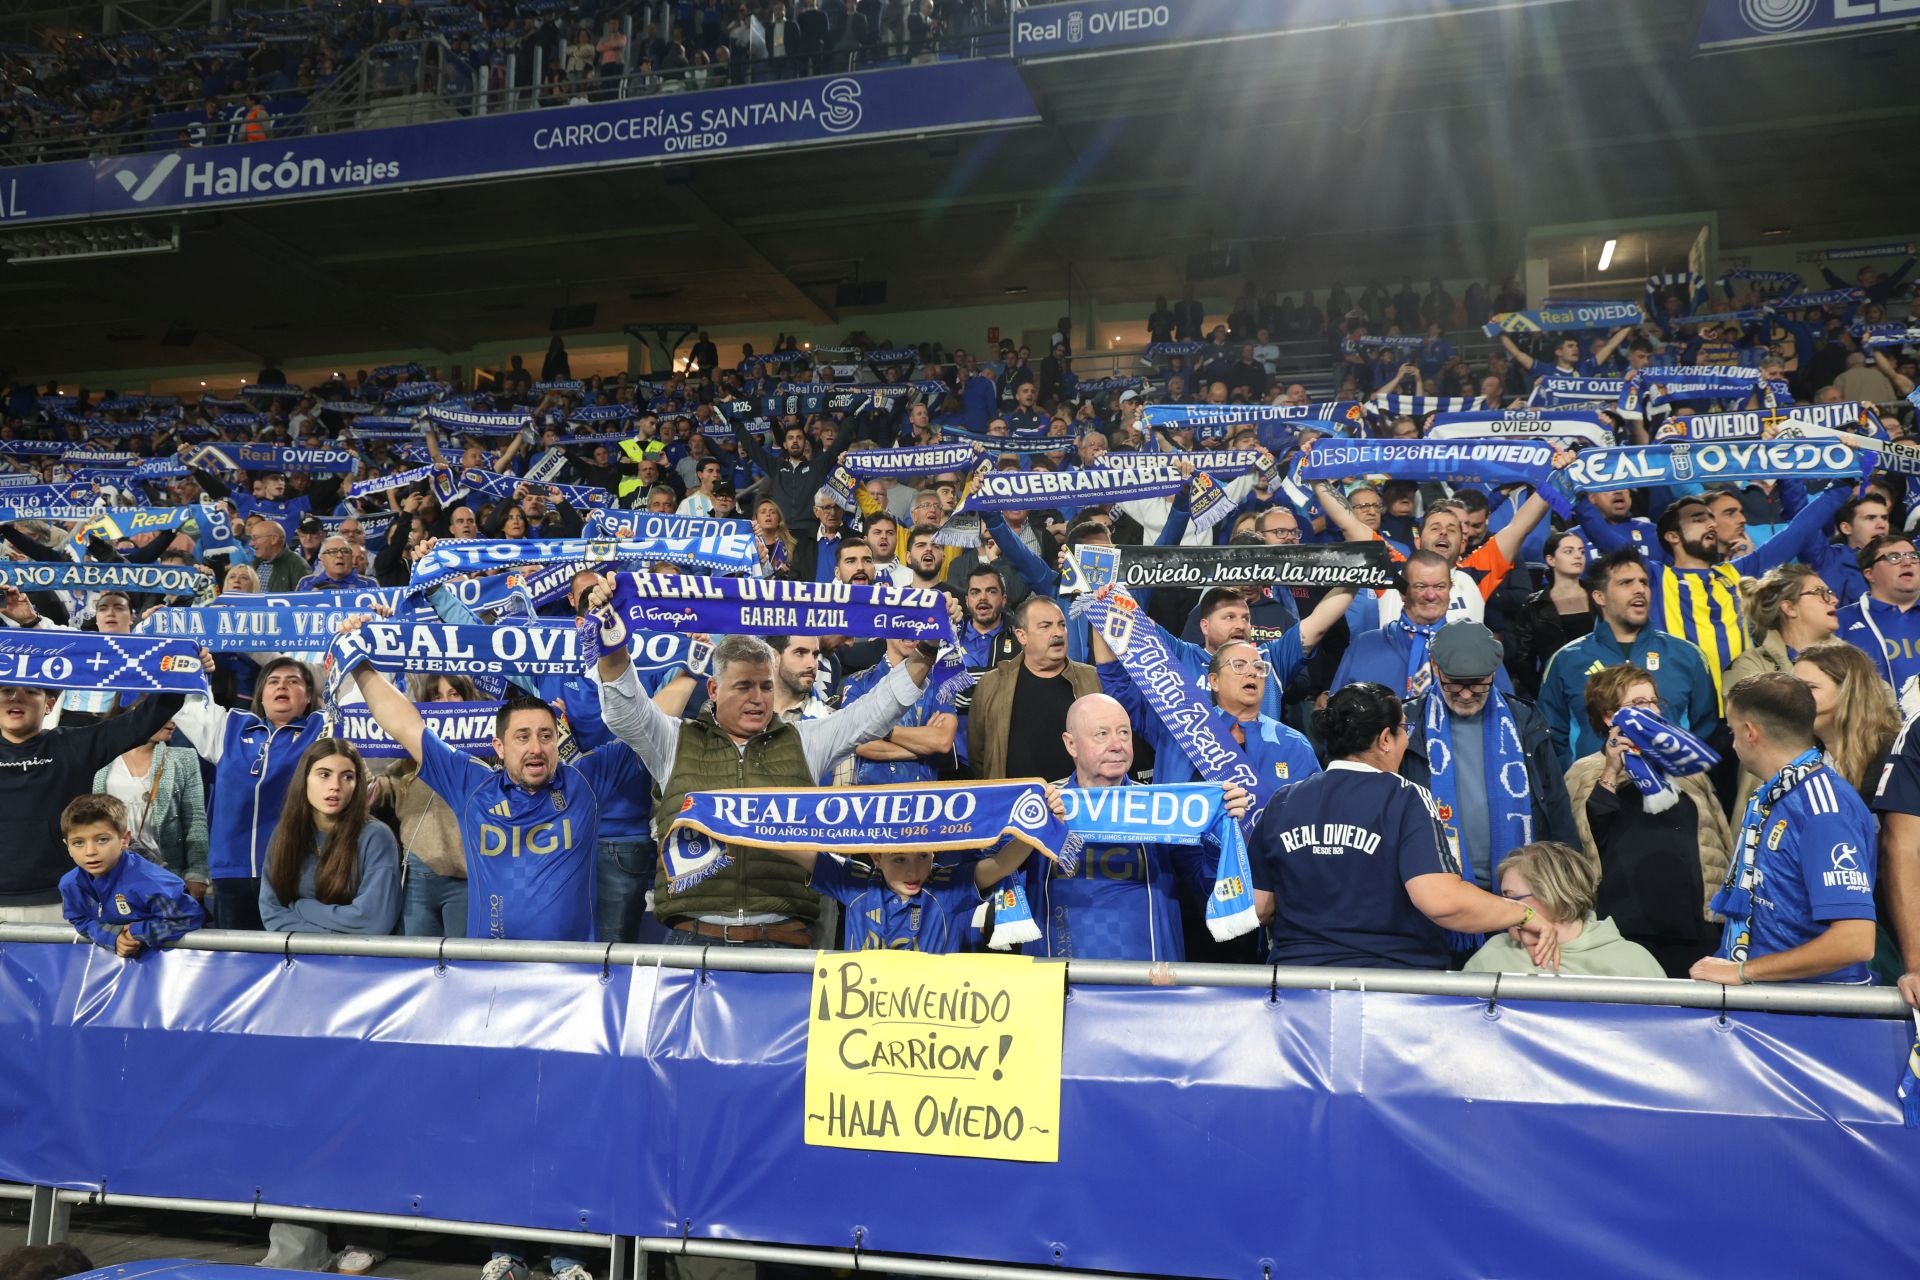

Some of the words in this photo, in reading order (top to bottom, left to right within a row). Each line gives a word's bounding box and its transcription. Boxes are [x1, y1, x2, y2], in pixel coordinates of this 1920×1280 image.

[1017, 18, 1062, 45] Real
[1088, 5, 1170, 34] OVIEDO
[533, 109, 694, 151] CARROCERÍAS
[700, 97, 816, 130] SANTANA
[665, 132, 728, 153] OVIEDO
[184, 158, 326, 198] Halcón
[330, 159, 400, 184] viajes
[1541, 311, 1575, 324] Real
[1578, 304, 1637, 322] OVIEDO
[1503, 409, 1541, 420] Real
[1491, 421, 1552, 433] OVIEDO
[1692, 415, 1760, 440] OVIEDO
[238, 448, 277, 463] Real
[282, 449, 350, 464] OVIEDO
[1568, 451, 1665, 487] REAL
[1696, 443, 1854, 473] OVIEDO
[15, 506, 47, 518] Real
[51, 506, 107, 518] OVIEDO
[130, 508, 178, 529] Real
[592, 509, 638, 538] Real
[645, 517, 737, 539] OVIEDO
[417, 543, 521, 577] ESTO
[15, 567, 55, 586] NO
[1127, 562, 1208, 585] Oviedo,
[1214, 560, 1274, 583] hasta
[1279, 561, 1303, 582] la
[1310, 561, 1387, 585] muerte
[632, 572, 724, 600] REAL
[737, 577, 850, 604] OVIEDO
[869, 585, 939, 609] 1926
[135, 606, 207, 637] PEÑA
[217, 610, 283, 637] AZUL
[629, 605, 643, 620] El
[741, 606, 798, 627] GARRA
[805, 608, 849, 628] AZUL
[873, 613, 886, 629] El
[221, 638, 245, 649] por
[251, 640, 266, 648] un
[337, 623, 474, 660] REAL
[404, 658, 503, 673] HEMOS
[0, 756, 53, 771] ampion
[712, 795, 807, 828] REAL
[815, 791, 977, 825] OVIEDO
[479, 818, 573, 858] DIGI
[754, 825, 776, 836] 100
[778, 824, 808, 838] AÑOS
[810, 827, 825, 838] DE
[827, 828, 866, 840] GARRA
[900, 825, 929, 837] 1926
[939, 822, 973, 835] 2026
[1280, 824, 1316, 854] REAL
[1323, 823, 1382, 856] OVIEDO
[1312, 846, 1332, 855] DESDE
[1332, 846, 1344, 855] 1926
[1823, 870, 1869, 887] INTEGRA
